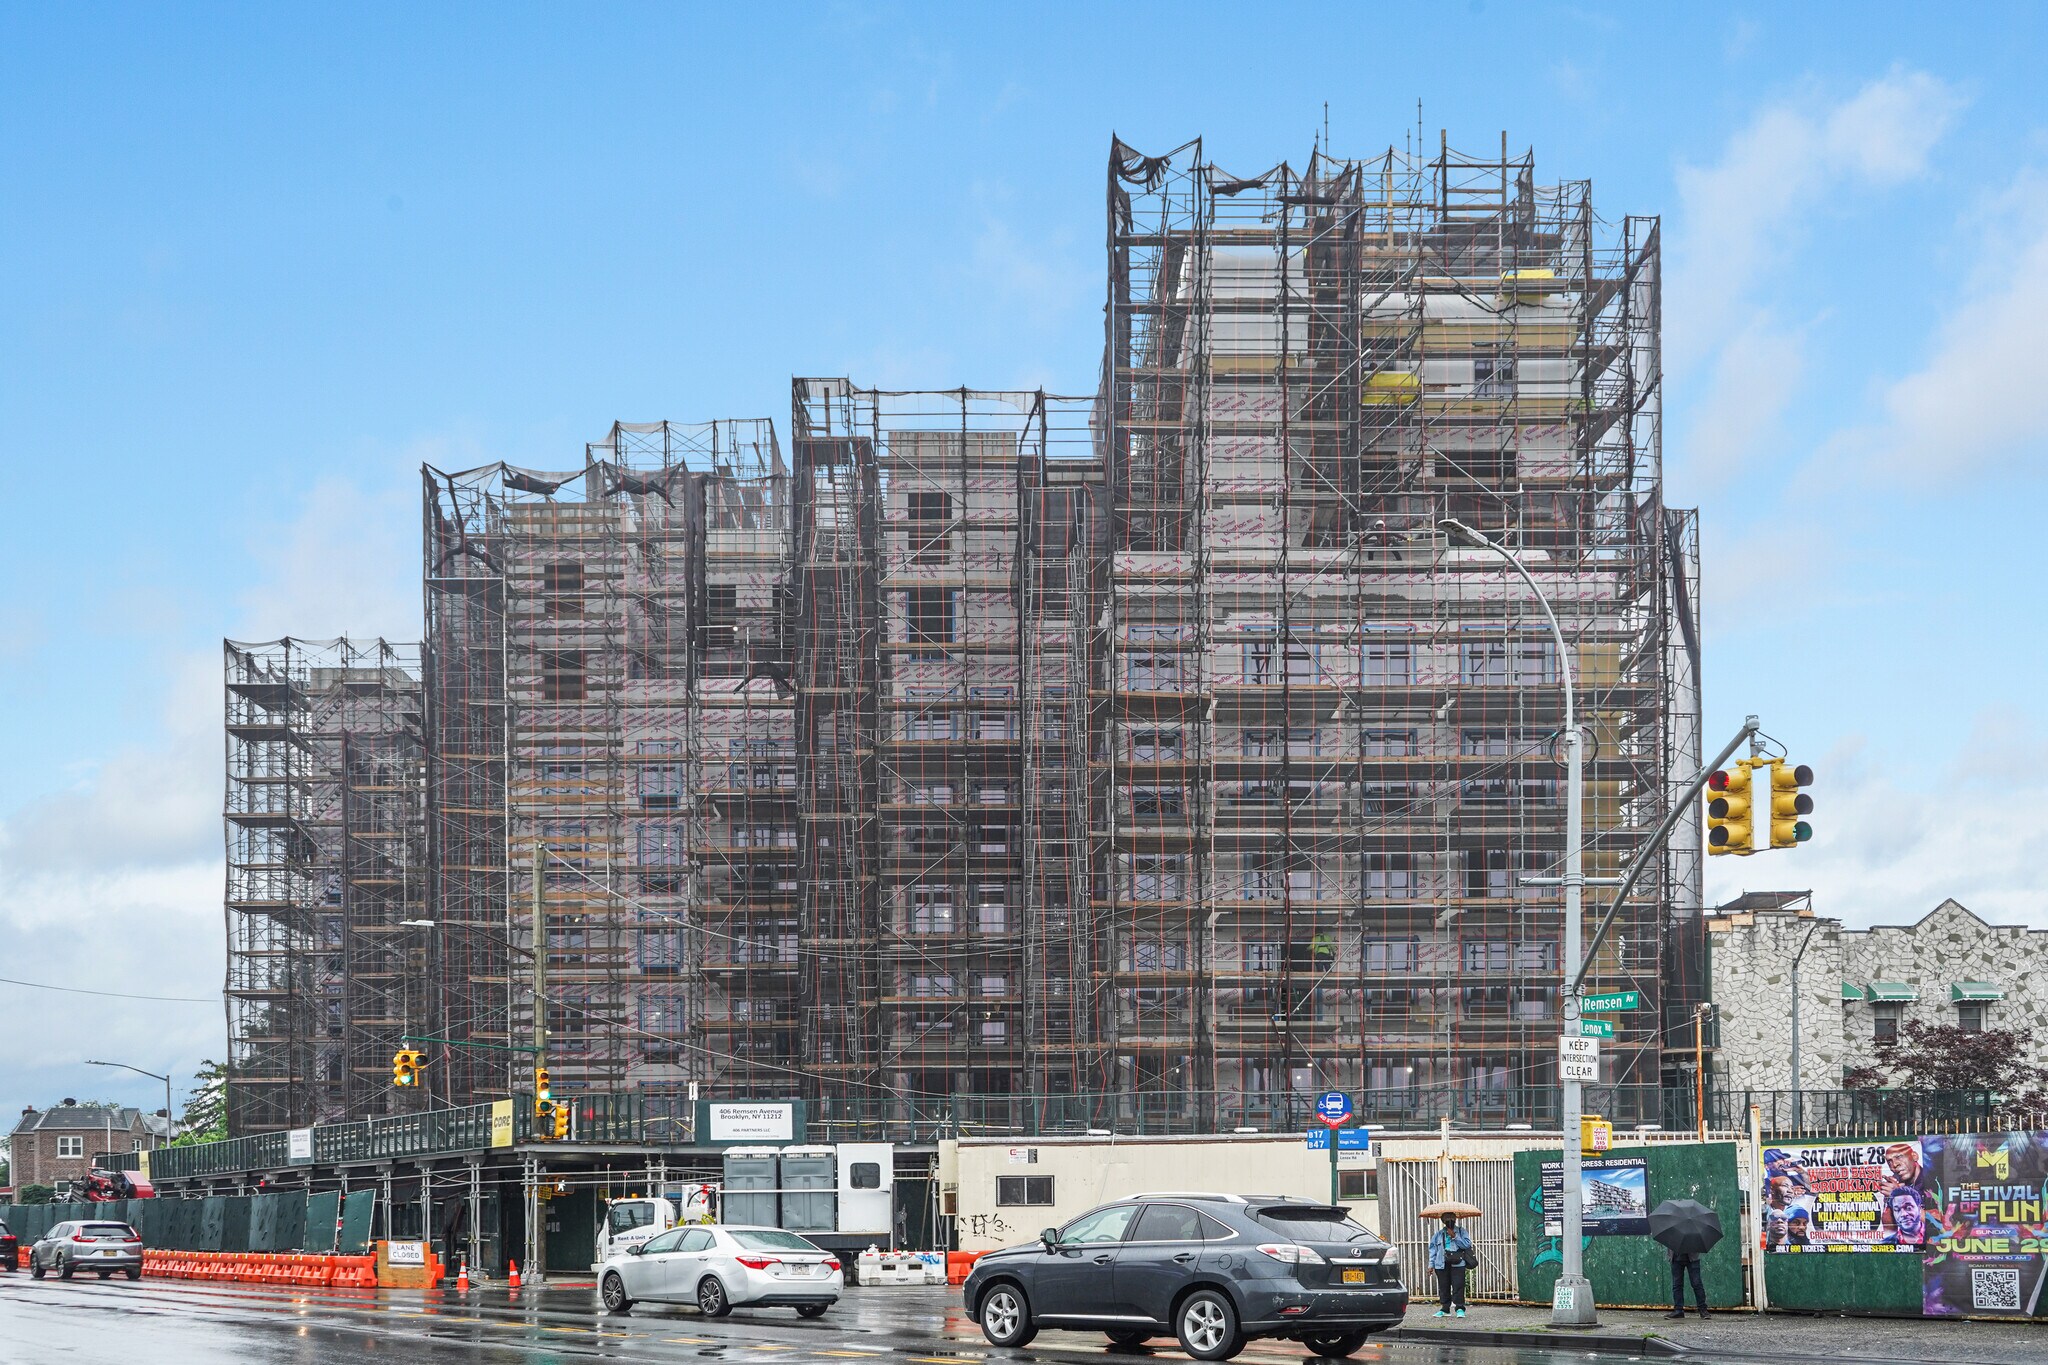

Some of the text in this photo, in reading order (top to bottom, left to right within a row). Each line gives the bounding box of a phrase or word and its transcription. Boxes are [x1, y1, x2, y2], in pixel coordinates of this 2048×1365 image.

[1584, 994, 1634, 1011] Remsen Av
[1581, 1021, 1612, 1035] Lenox Rd
[1569, 1040, 1590, 1051] KEEP
[1561, 1053, 1597, 1064] INTERSECTION
[1566, 1065, 1592, 1077] CLEAR
[494, 1115, 510, 1128] CORE
[1308, 1130, 1324, 1139] B17
[1308, 1140, 1325, 1148] B47
[1542, 1162, 1561, 1170] WORK
[1605, 1158, 1646, 1167] RESIDENTIAL
[1808, 1165, 1882, 1182] WORLD BASH
[1811, 1179, 1881, 1193] BROOKLYN
[1961, 1182, 1979, 1190] THE
[1818, 1192, 1874, 1203] SOUL SUPREME
[1948, 1185, 2039, 1202] FESTIVAL
[1813, 1201, 1880, 1212] LP INTERNATIONAL
[1960, 1201, 1979, 1213] OF
[1980, 1201, 2040, 1222] FUN
[1818, 1211, 1875, 1222] KILLAMANJARO
[1824, 1221, 1870, 1231] EARTH RULER
[1810, 1231, 1884, 1239] CROWN HILL THEATRE
[1828, 1245, 1914, 1253] WORLDBASHSERIES.COM
[1936, 1238, 2009, 1253] JUNE
